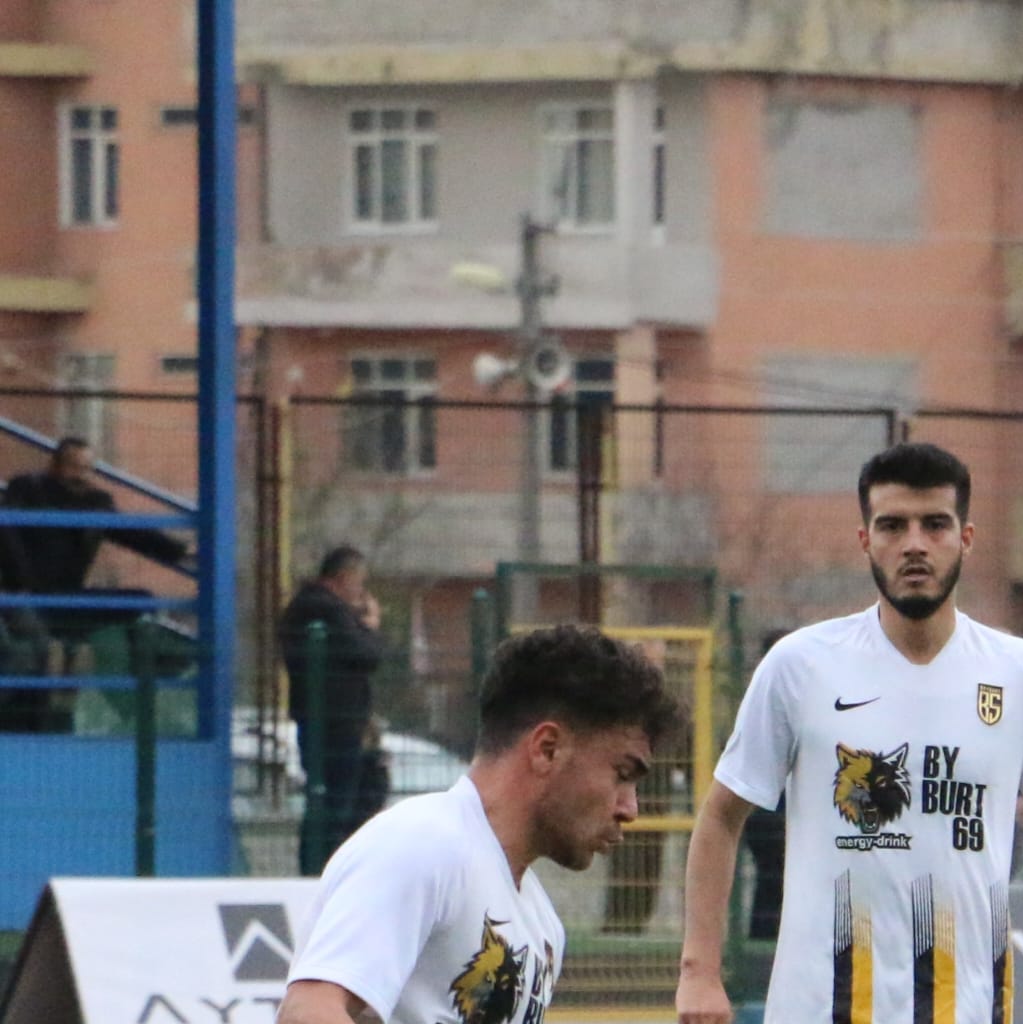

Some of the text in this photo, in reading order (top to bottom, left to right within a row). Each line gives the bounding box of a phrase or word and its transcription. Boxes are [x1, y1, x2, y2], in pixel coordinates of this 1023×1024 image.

[923, 745, 960, 779] BY
[922, 780, 986, 817] BURT
[836, 834, 911, 849] energy-drink
[953, 817, 984, 851] 69
